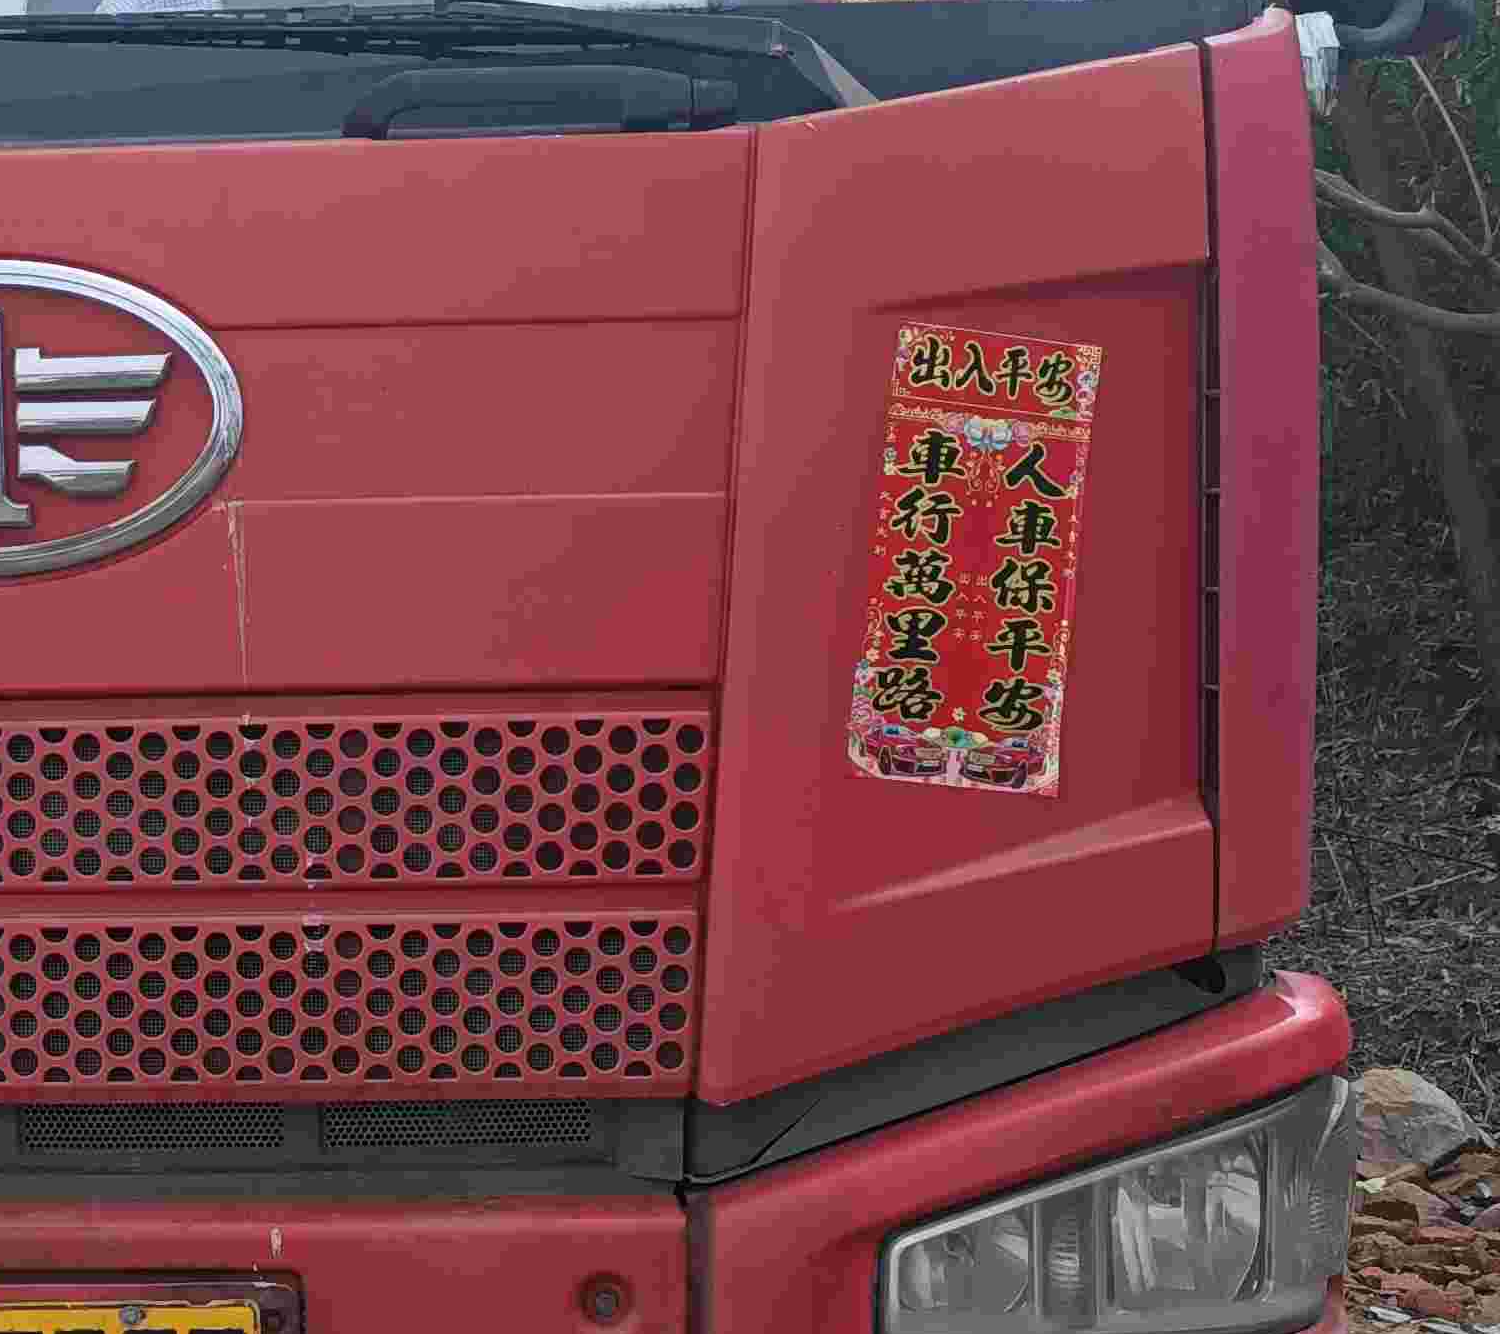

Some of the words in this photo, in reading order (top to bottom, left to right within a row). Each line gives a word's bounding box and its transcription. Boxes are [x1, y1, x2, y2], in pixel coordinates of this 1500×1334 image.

[910, 336, 1076, 406] 出入平安
[872, 429, 967, 722] 車行萬里路
[979, 442, 1068, 733] 人車保平安
